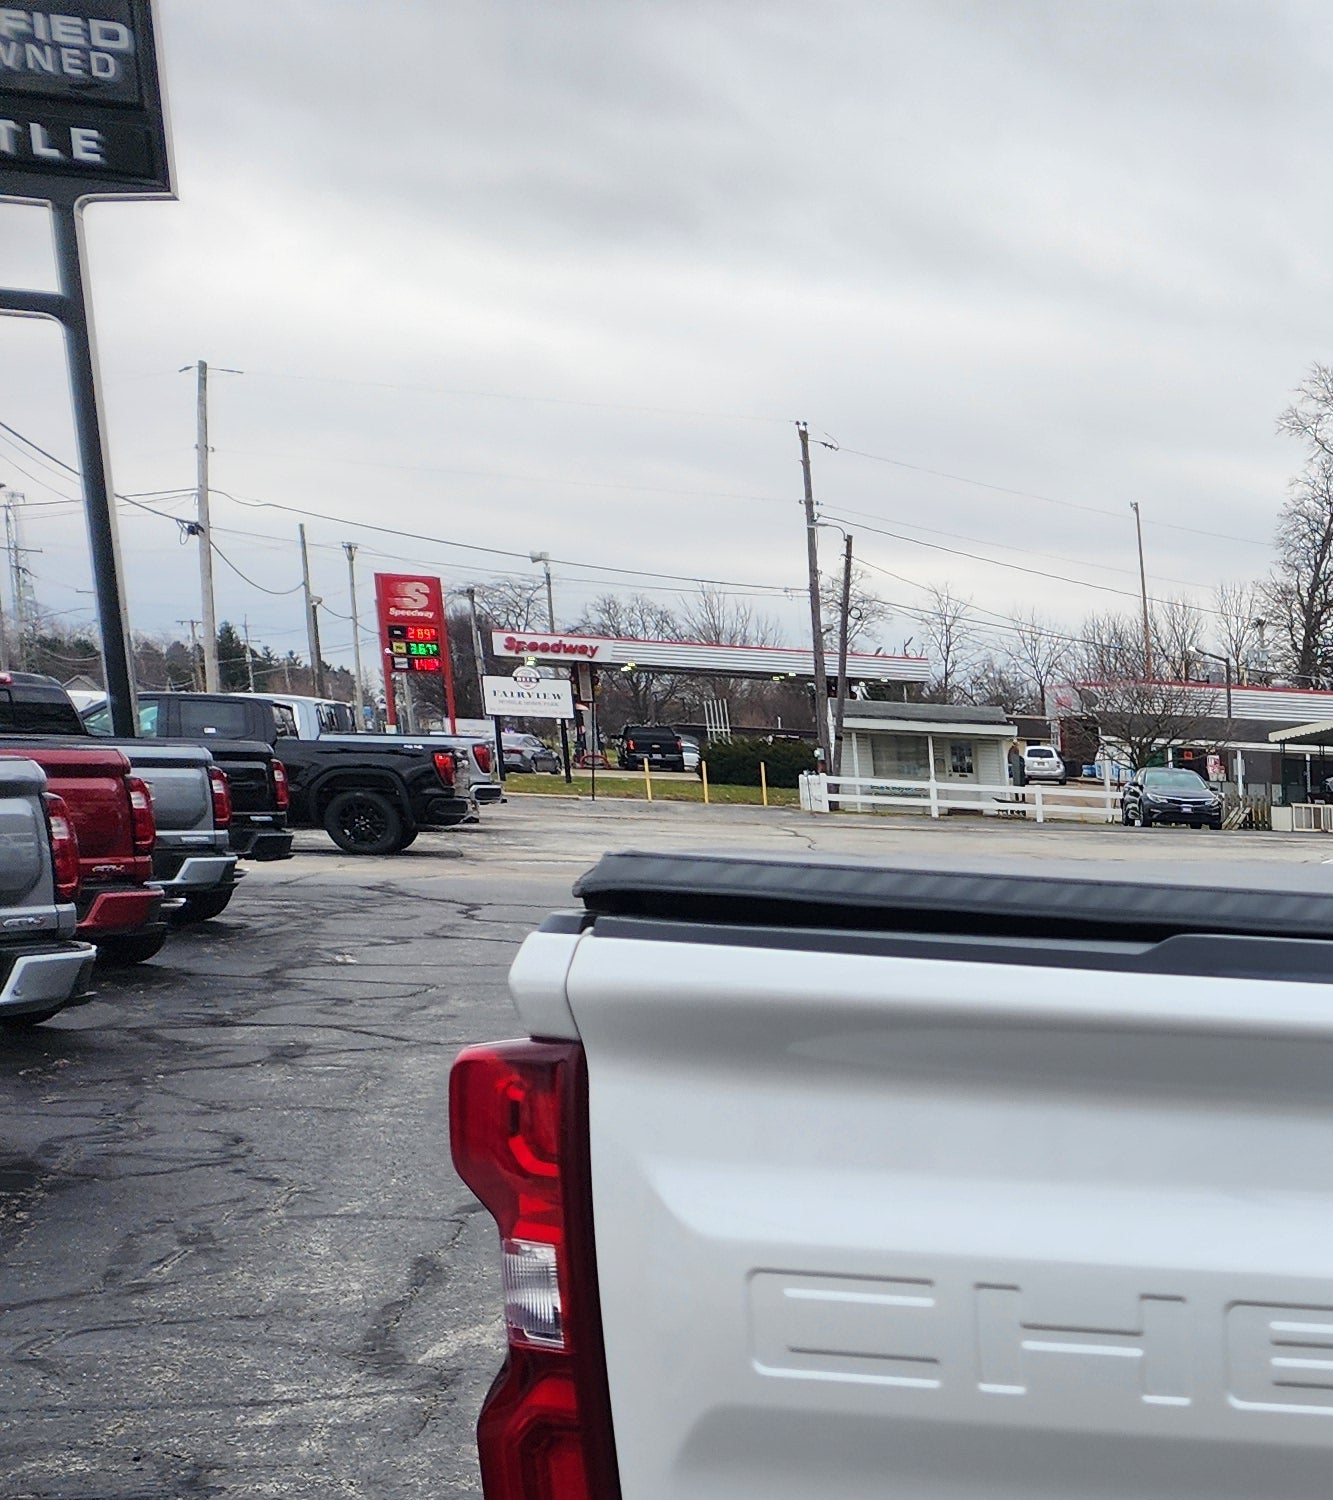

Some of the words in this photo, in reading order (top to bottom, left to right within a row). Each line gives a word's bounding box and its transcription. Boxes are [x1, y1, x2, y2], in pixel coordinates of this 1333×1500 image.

[389, 607, 434, 618] Speedway
[503, 635, 599, 659] Speedway
[492, 689, 563, 700] FAIRVIEW
